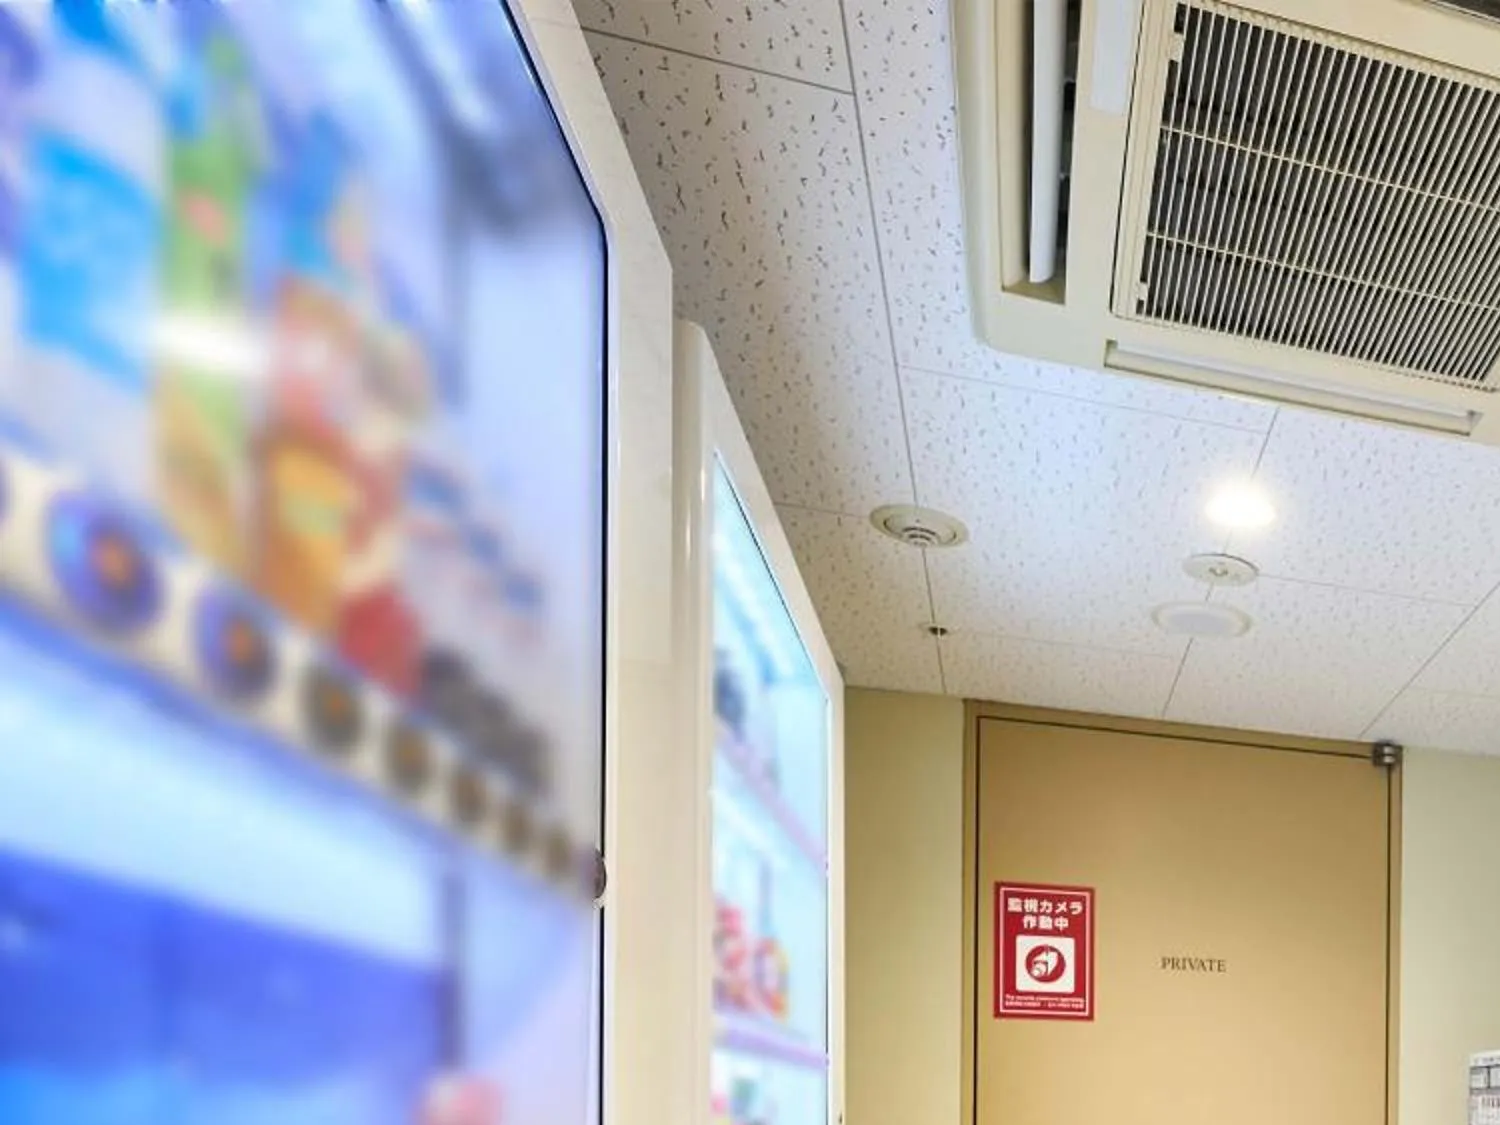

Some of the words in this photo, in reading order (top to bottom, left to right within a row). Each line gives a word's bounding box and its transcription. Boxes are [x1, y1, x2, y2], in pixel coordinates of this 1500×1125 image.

[1007, 897, 1084, 915] 監視カメラ
[1022, 915, 1069, 930] 作動中
[1161, 956, 1227, 973] PRIVATE
